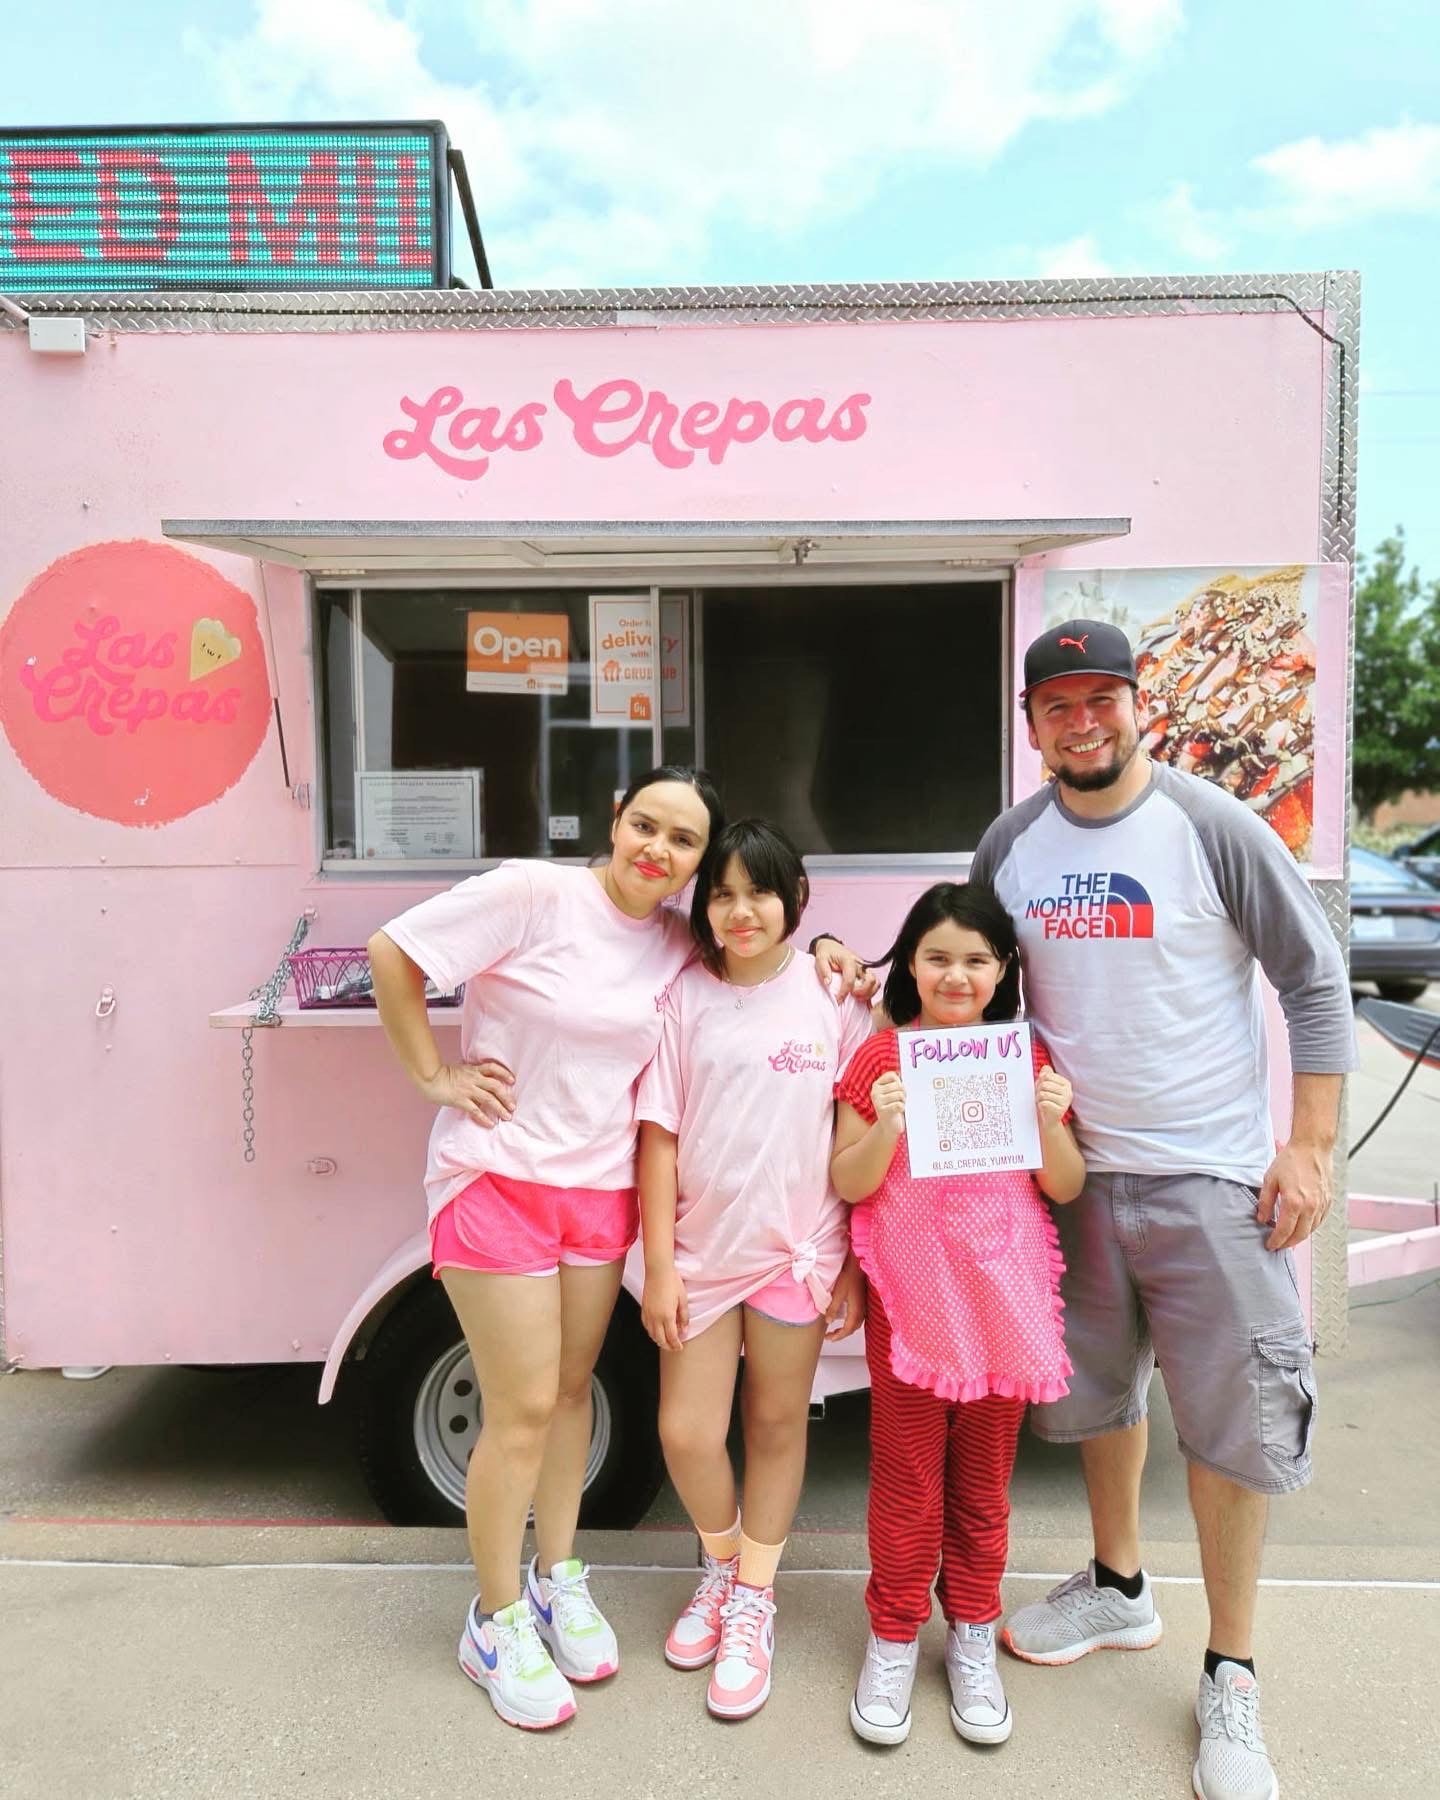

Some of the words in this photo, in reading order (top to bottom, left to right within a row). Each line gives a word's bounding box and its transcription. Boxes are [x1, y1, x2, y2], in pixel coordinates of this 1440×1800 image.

[383, 386, 547, 481] Las
[554, 379, 872, 469] Crepas
[62, 615, 178, 688] Las
[473, 626, 562, 664] Open
[601, 630, 679, 653] delivy
[624, 667, 677, 680] GRUBUB
[20, 662, 241, 736] Crepas
[1062, 872, 1108, 895] THE
[1025, 895, 1105, 920] NORTH
[1044, 917, 1103, 940] FACE
[780, 1039, 812, 1058] Las
[909, 1037, 989, 1069] FOLLOW
[997, 1030, 1022, 1059] US
[768, 1055, 827, 1074] Crepas
